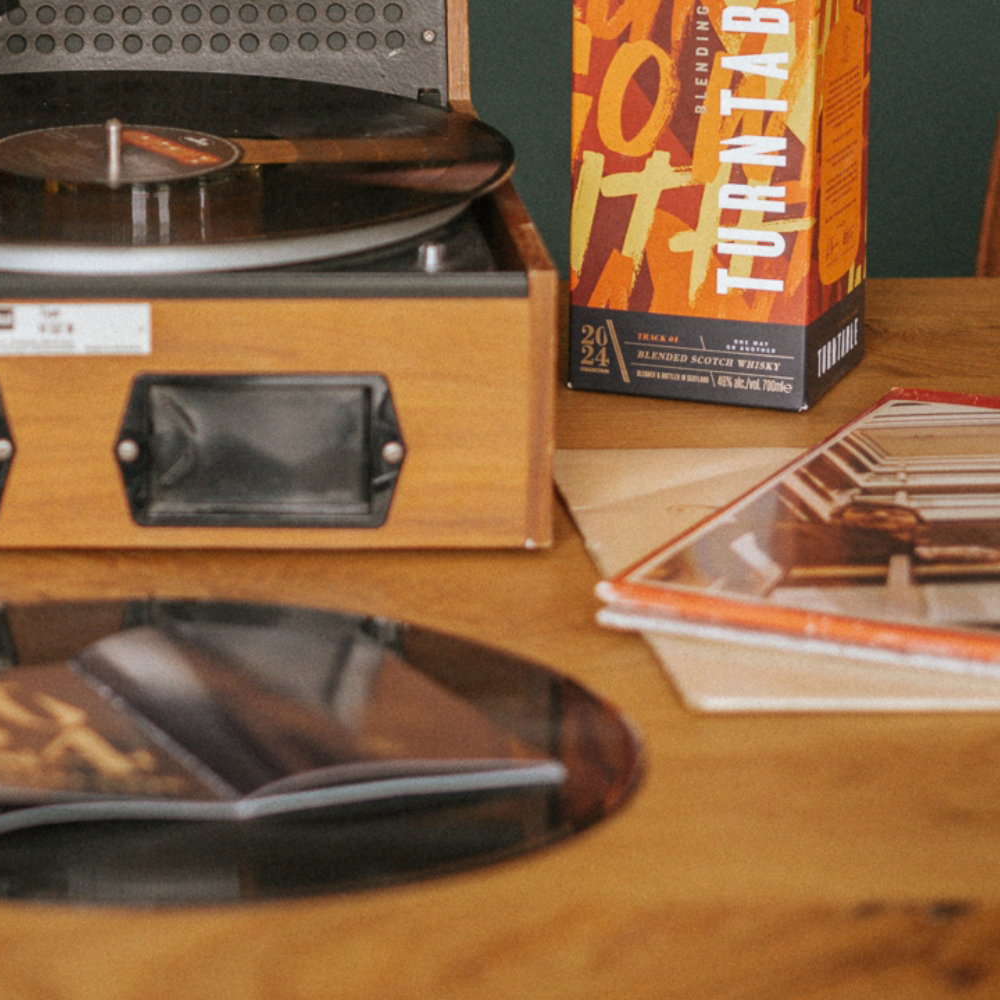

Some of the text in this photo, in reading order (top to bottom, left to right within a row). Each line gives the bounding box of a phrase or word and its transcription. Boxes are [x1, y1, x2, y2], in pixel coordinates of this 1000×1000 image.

[694, 5, 710, 114] BLENDING
[581, 324, 609, 347] 20
[637, 332, 667, 342] TRACK
[579, 345, 610, 367] 24
[636, 350, 782, 372] BLENDED SCOTCH WHISKY
